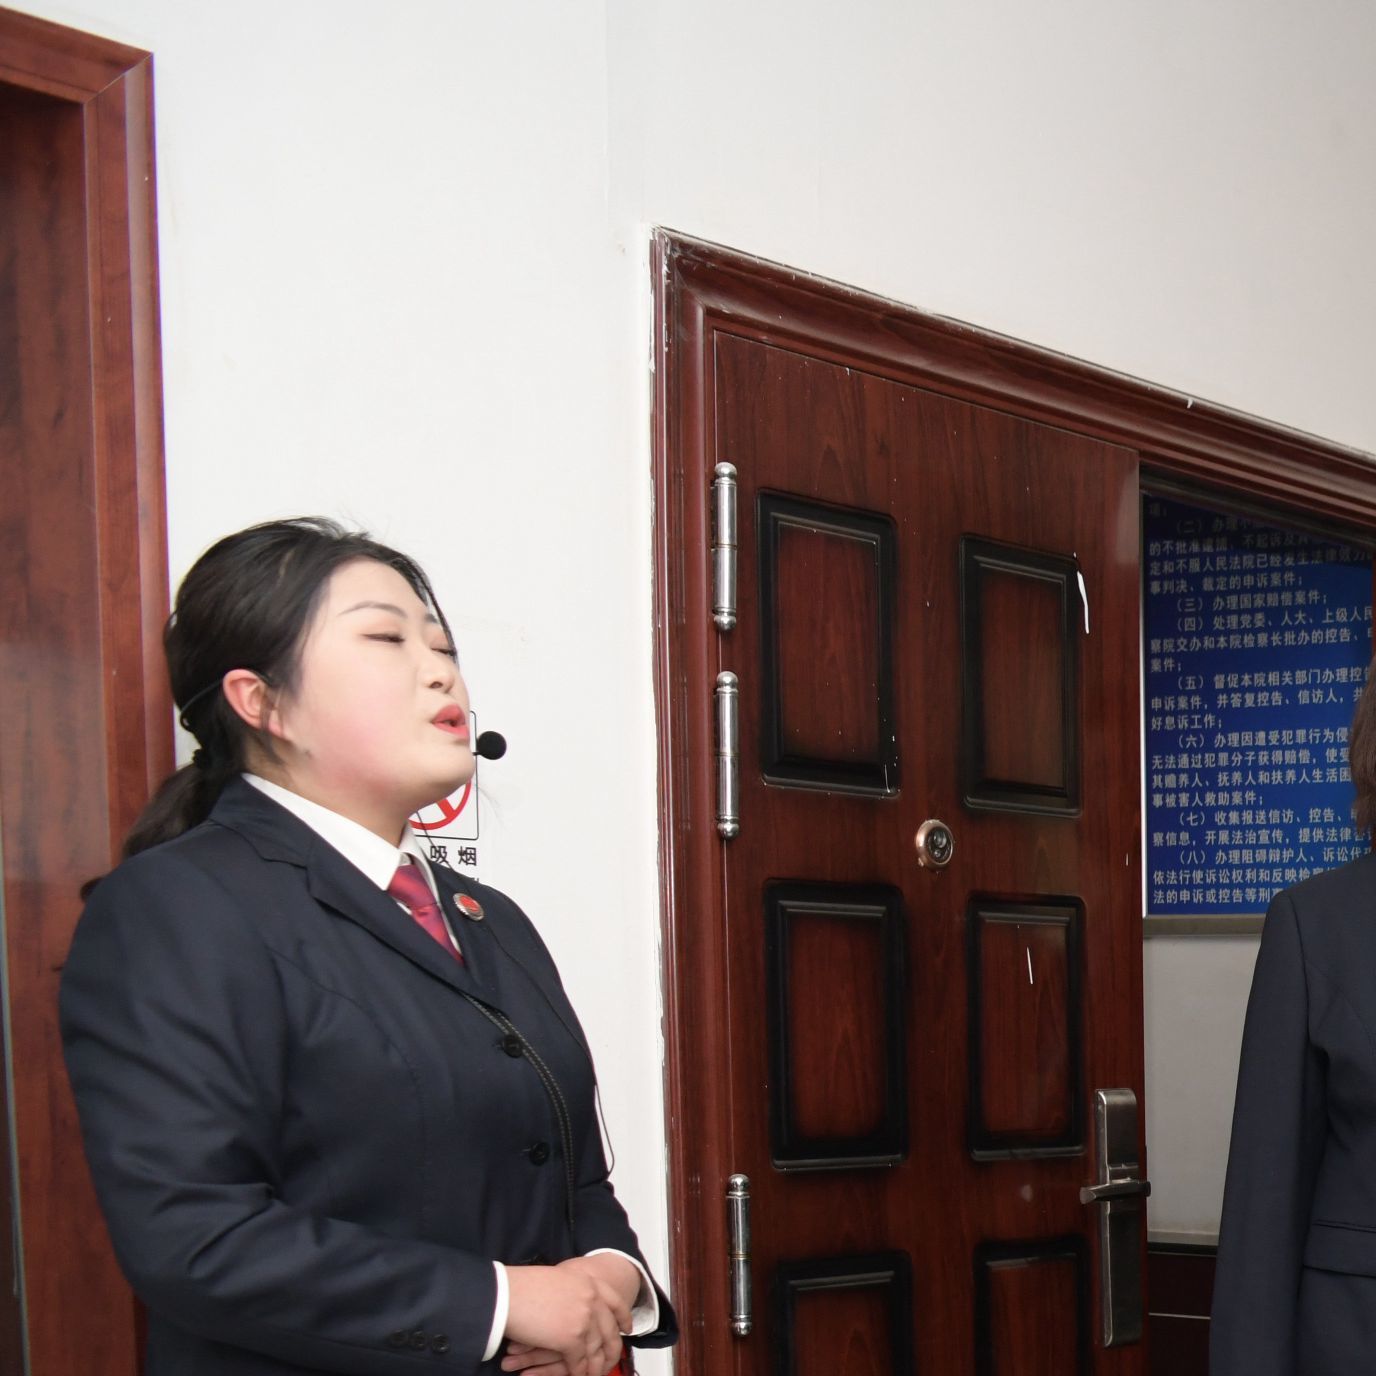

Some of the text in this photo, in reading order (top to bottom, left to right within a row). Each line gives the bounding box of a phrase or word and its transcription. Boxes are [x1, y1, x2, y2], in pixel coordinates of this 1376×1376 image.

[1151, 657, 1182, 673] 案件；
[1151, 713, 1223, 731] 好息诉工作；
[1178, 727, 1351, 749] （六）办理因遭受犯罪行为侵
[430, 845, 477, 866] 吸烟
[1153, 866, 1336, 886] 依法行使诉讼权利和反映检
